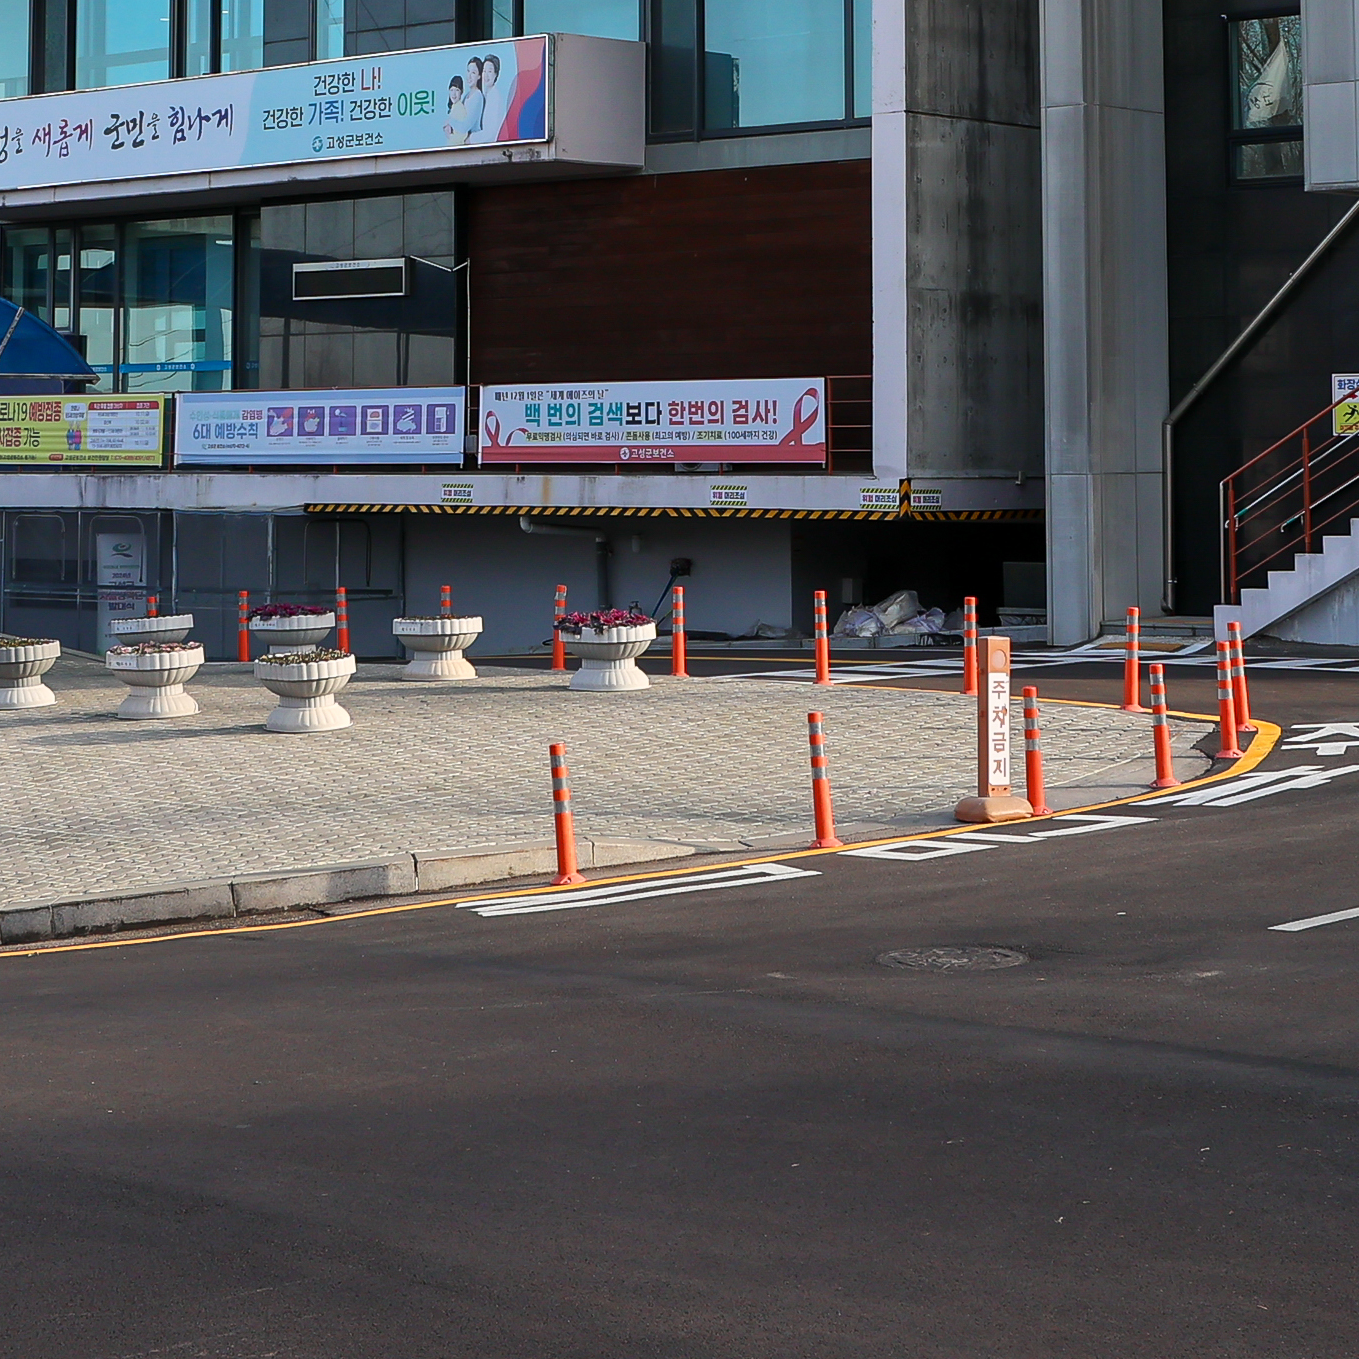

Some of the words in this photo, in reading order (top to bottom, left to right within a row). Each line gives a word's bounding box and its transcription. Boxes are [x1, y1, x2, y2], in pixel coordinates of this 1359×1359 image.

[313, 72, 356, 96] 건강한
[361, 67, 382, 91] 나!
[262, 106, 304, 130] 건강한
[308, 99, 344, 126] 가족!
[349, 97, 393, 121] 건강한
[397, 90, 435, 116] 이웃!
[32, 119, 93, 158] 새롭게
[104, 111, 160, 150] 군민을
[167, 104, 234, 145] 힘나게
[326, 132, 384, 150] 고성군보건소
[242, 409, 263, 421] 감염병
[525, 403, 541, 427] 백
[547, 402, 581, 426] 번의
[588, 401, 662, 427] 검색보다
[668, 400, 725, 426] 한번의
[732, 399, 778, 425] 검사!
[23, 427, 41, 447] 가능
[192, 423, 211, 440] 6대
[214, 422, 258, 440] 예방수칙
[631, 448, 675, 459] 고성군보건소
[991, 680, 1007, 778] 주차금지
